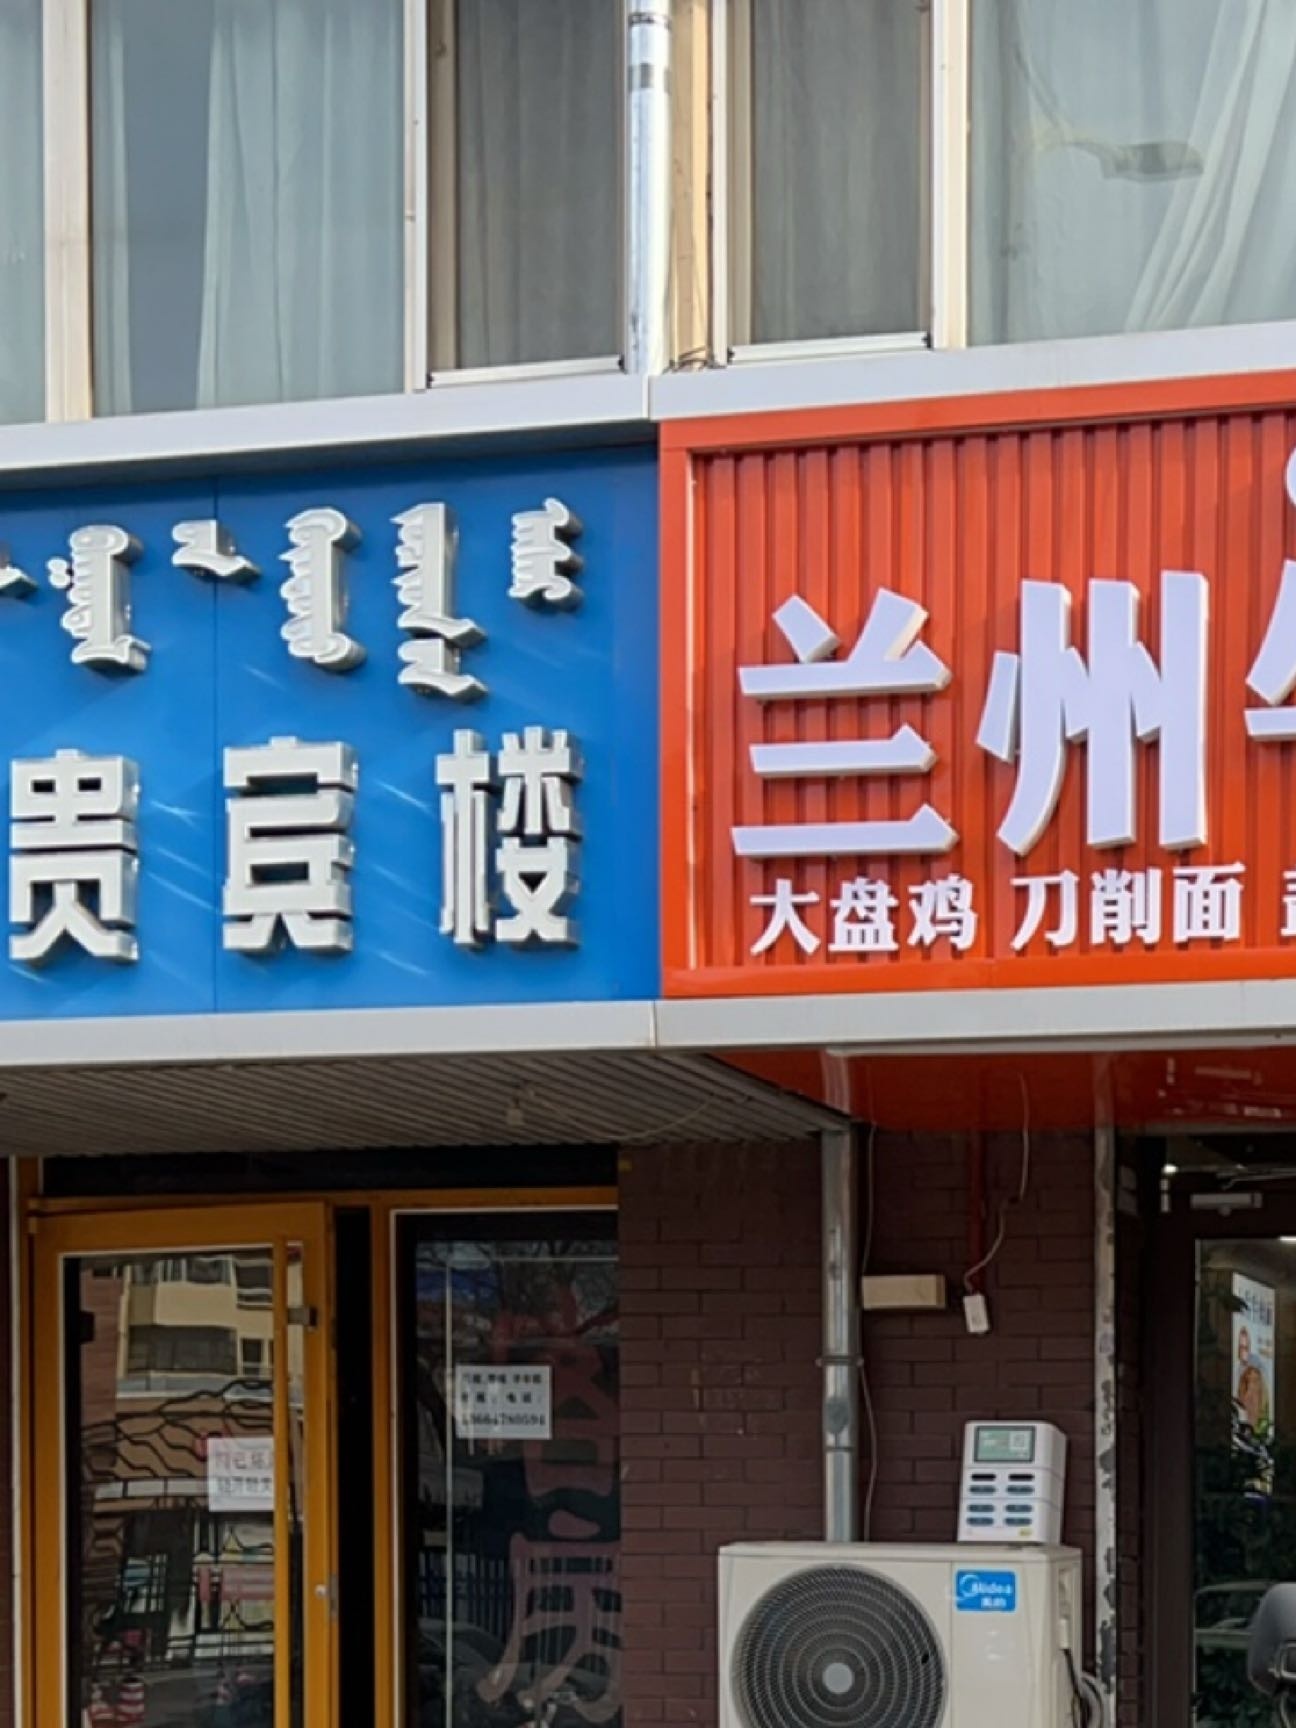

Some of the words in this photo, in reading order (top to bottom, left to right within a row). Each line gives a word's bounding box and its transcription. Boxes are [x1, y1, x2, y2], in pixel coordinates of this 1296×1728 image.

[9, 725, 583, 967] 贵宾楼
[750, 873, 978, 956] 大盘鸡
[1010, 860, 1246, 951] 刀削面
